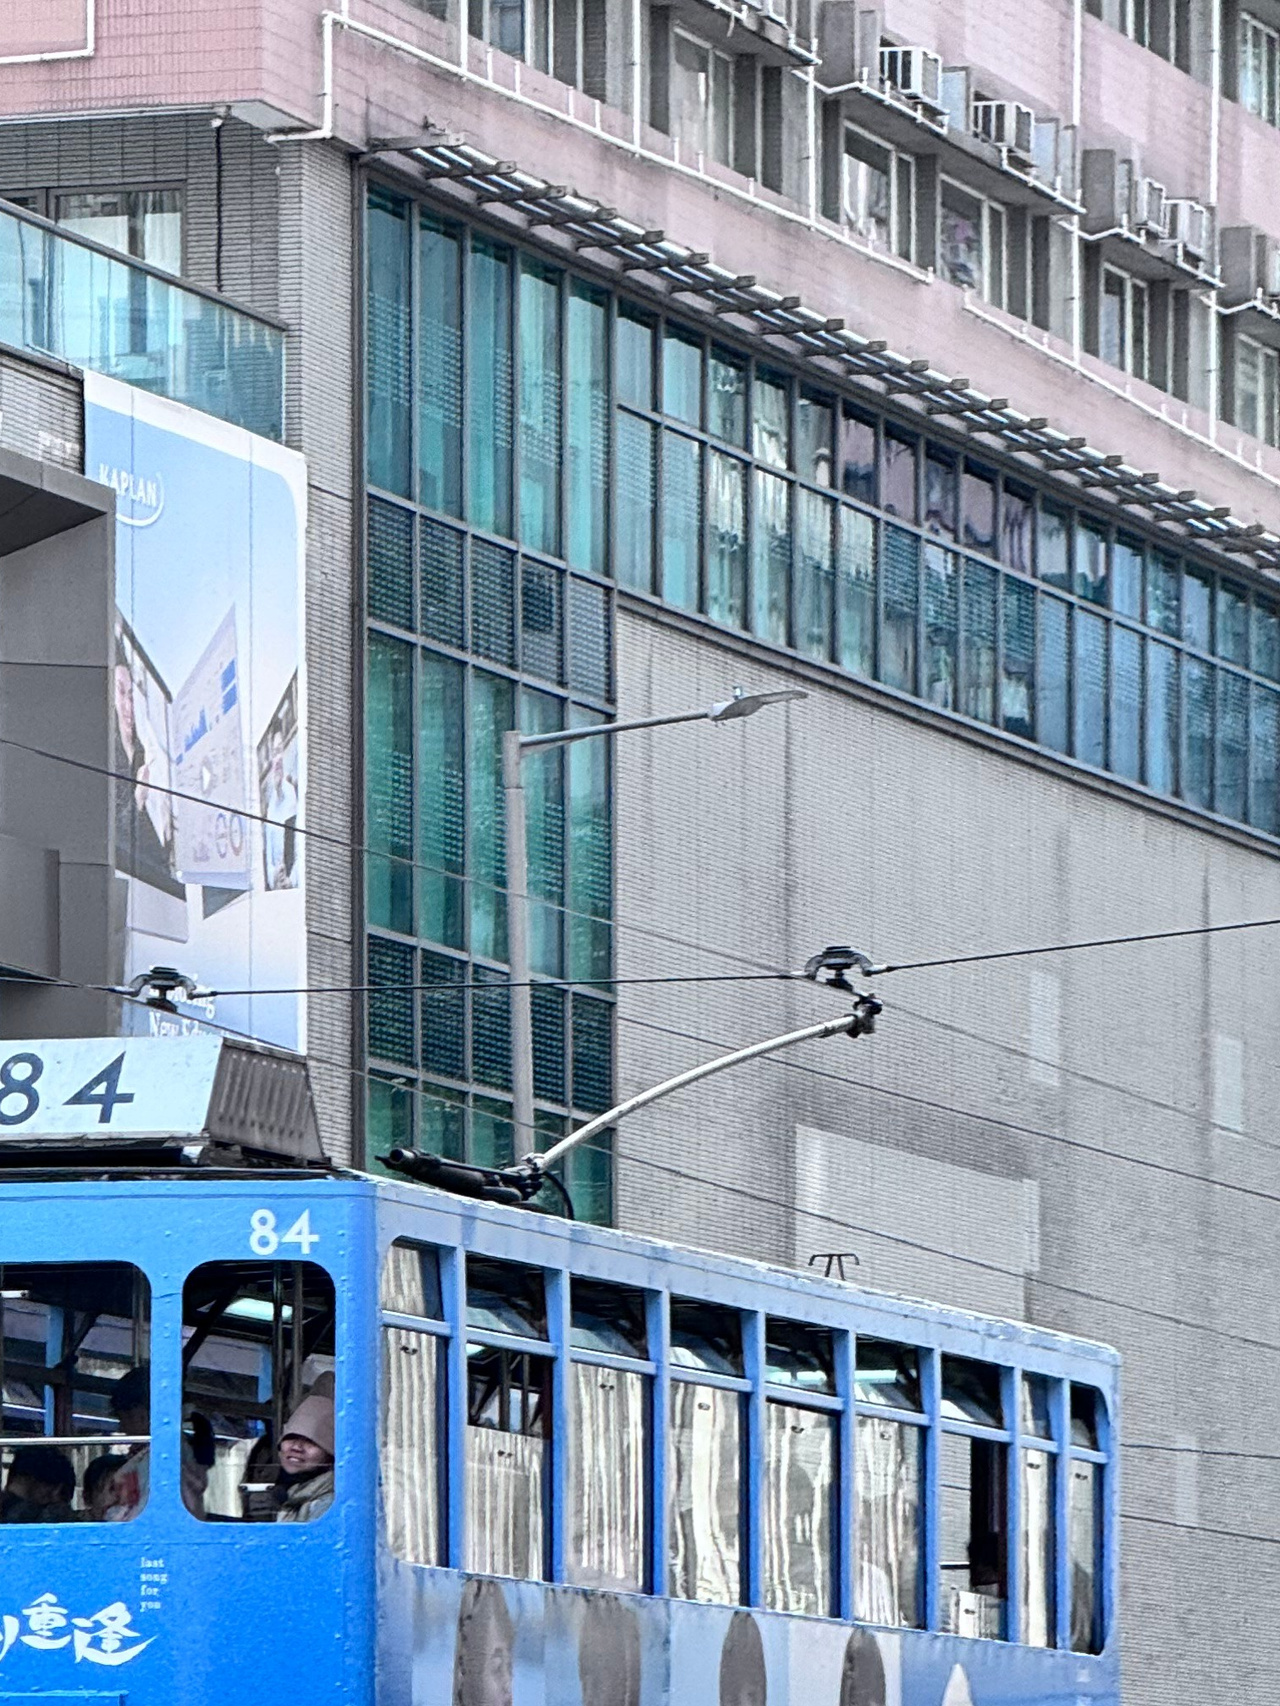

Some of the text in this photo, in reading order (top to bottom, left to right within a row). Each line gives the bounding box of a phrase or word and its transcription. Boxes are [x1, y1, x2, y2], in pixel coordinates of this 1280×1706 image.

[99, 462, 157, 508] KAPLAN
[248, 1208, 319, 1256] 84
[140, 1557, 165, 1568] last
[140, 1573, 168, 1585] song
[140, 1584, 160, 1596] for
[140, 1601, 162, 1613] you
